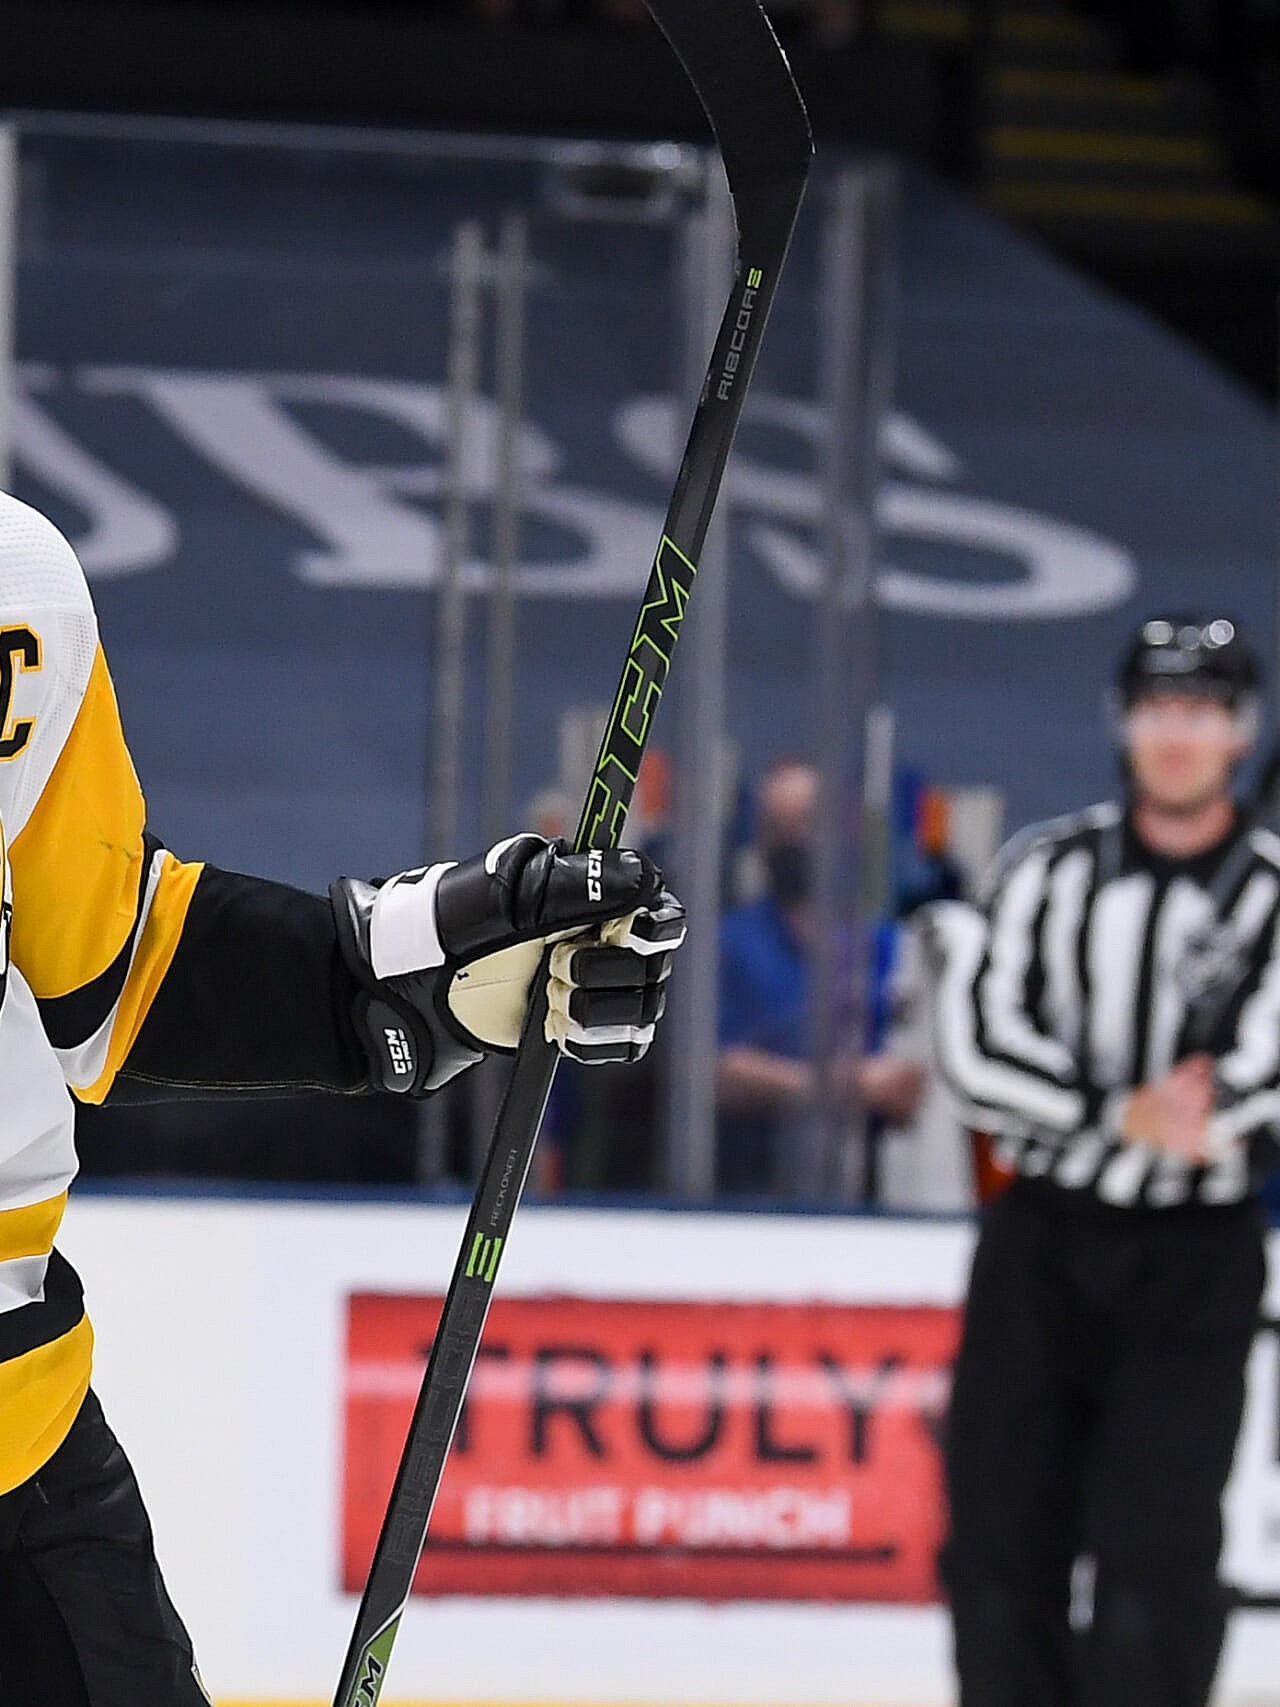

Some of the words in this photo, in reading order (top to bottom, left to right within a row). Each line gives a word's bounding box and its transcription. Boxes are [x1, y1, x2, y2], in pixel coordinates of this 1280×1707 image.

[575, 533, 698, 853] CCM
[587, 849, 603, 902] CCM
[383, 1028, 407, 1074] CCM
[420, 1346, 903, 1464] TRULY
